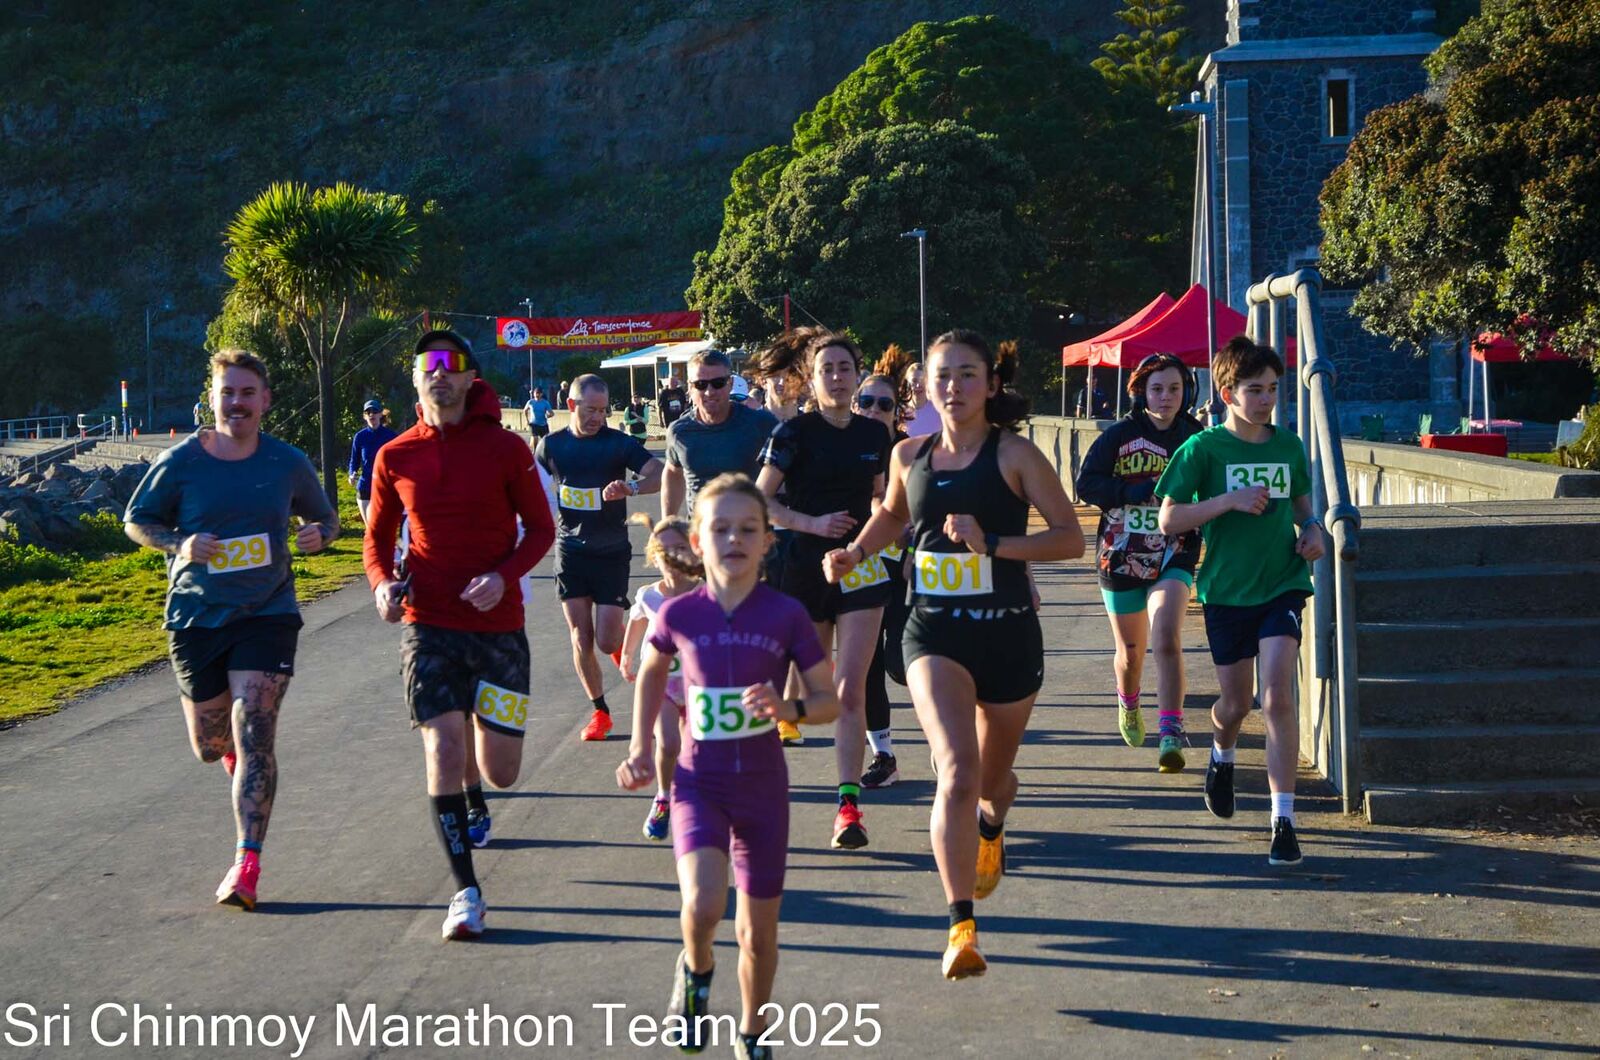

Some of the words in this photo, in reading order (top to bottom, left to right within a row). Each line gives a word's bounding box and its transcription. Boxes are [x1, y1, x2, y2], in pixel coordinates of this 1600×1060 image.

[531, 335, 547, 345] Sri
[550, 334, 600, 346] Chinmoy
[605, 331, 662, 344] Marathon
[666, 328, 697, 339] Team
[1232, 466, 1287, 493] 354
[562, 488, 594, 508] 631
[1128, 507, 1159, 531] 35
[210, 537, 266, 570] 629
[922, 555, 981, 591] 601
[479, 686, 529, 727] 635
